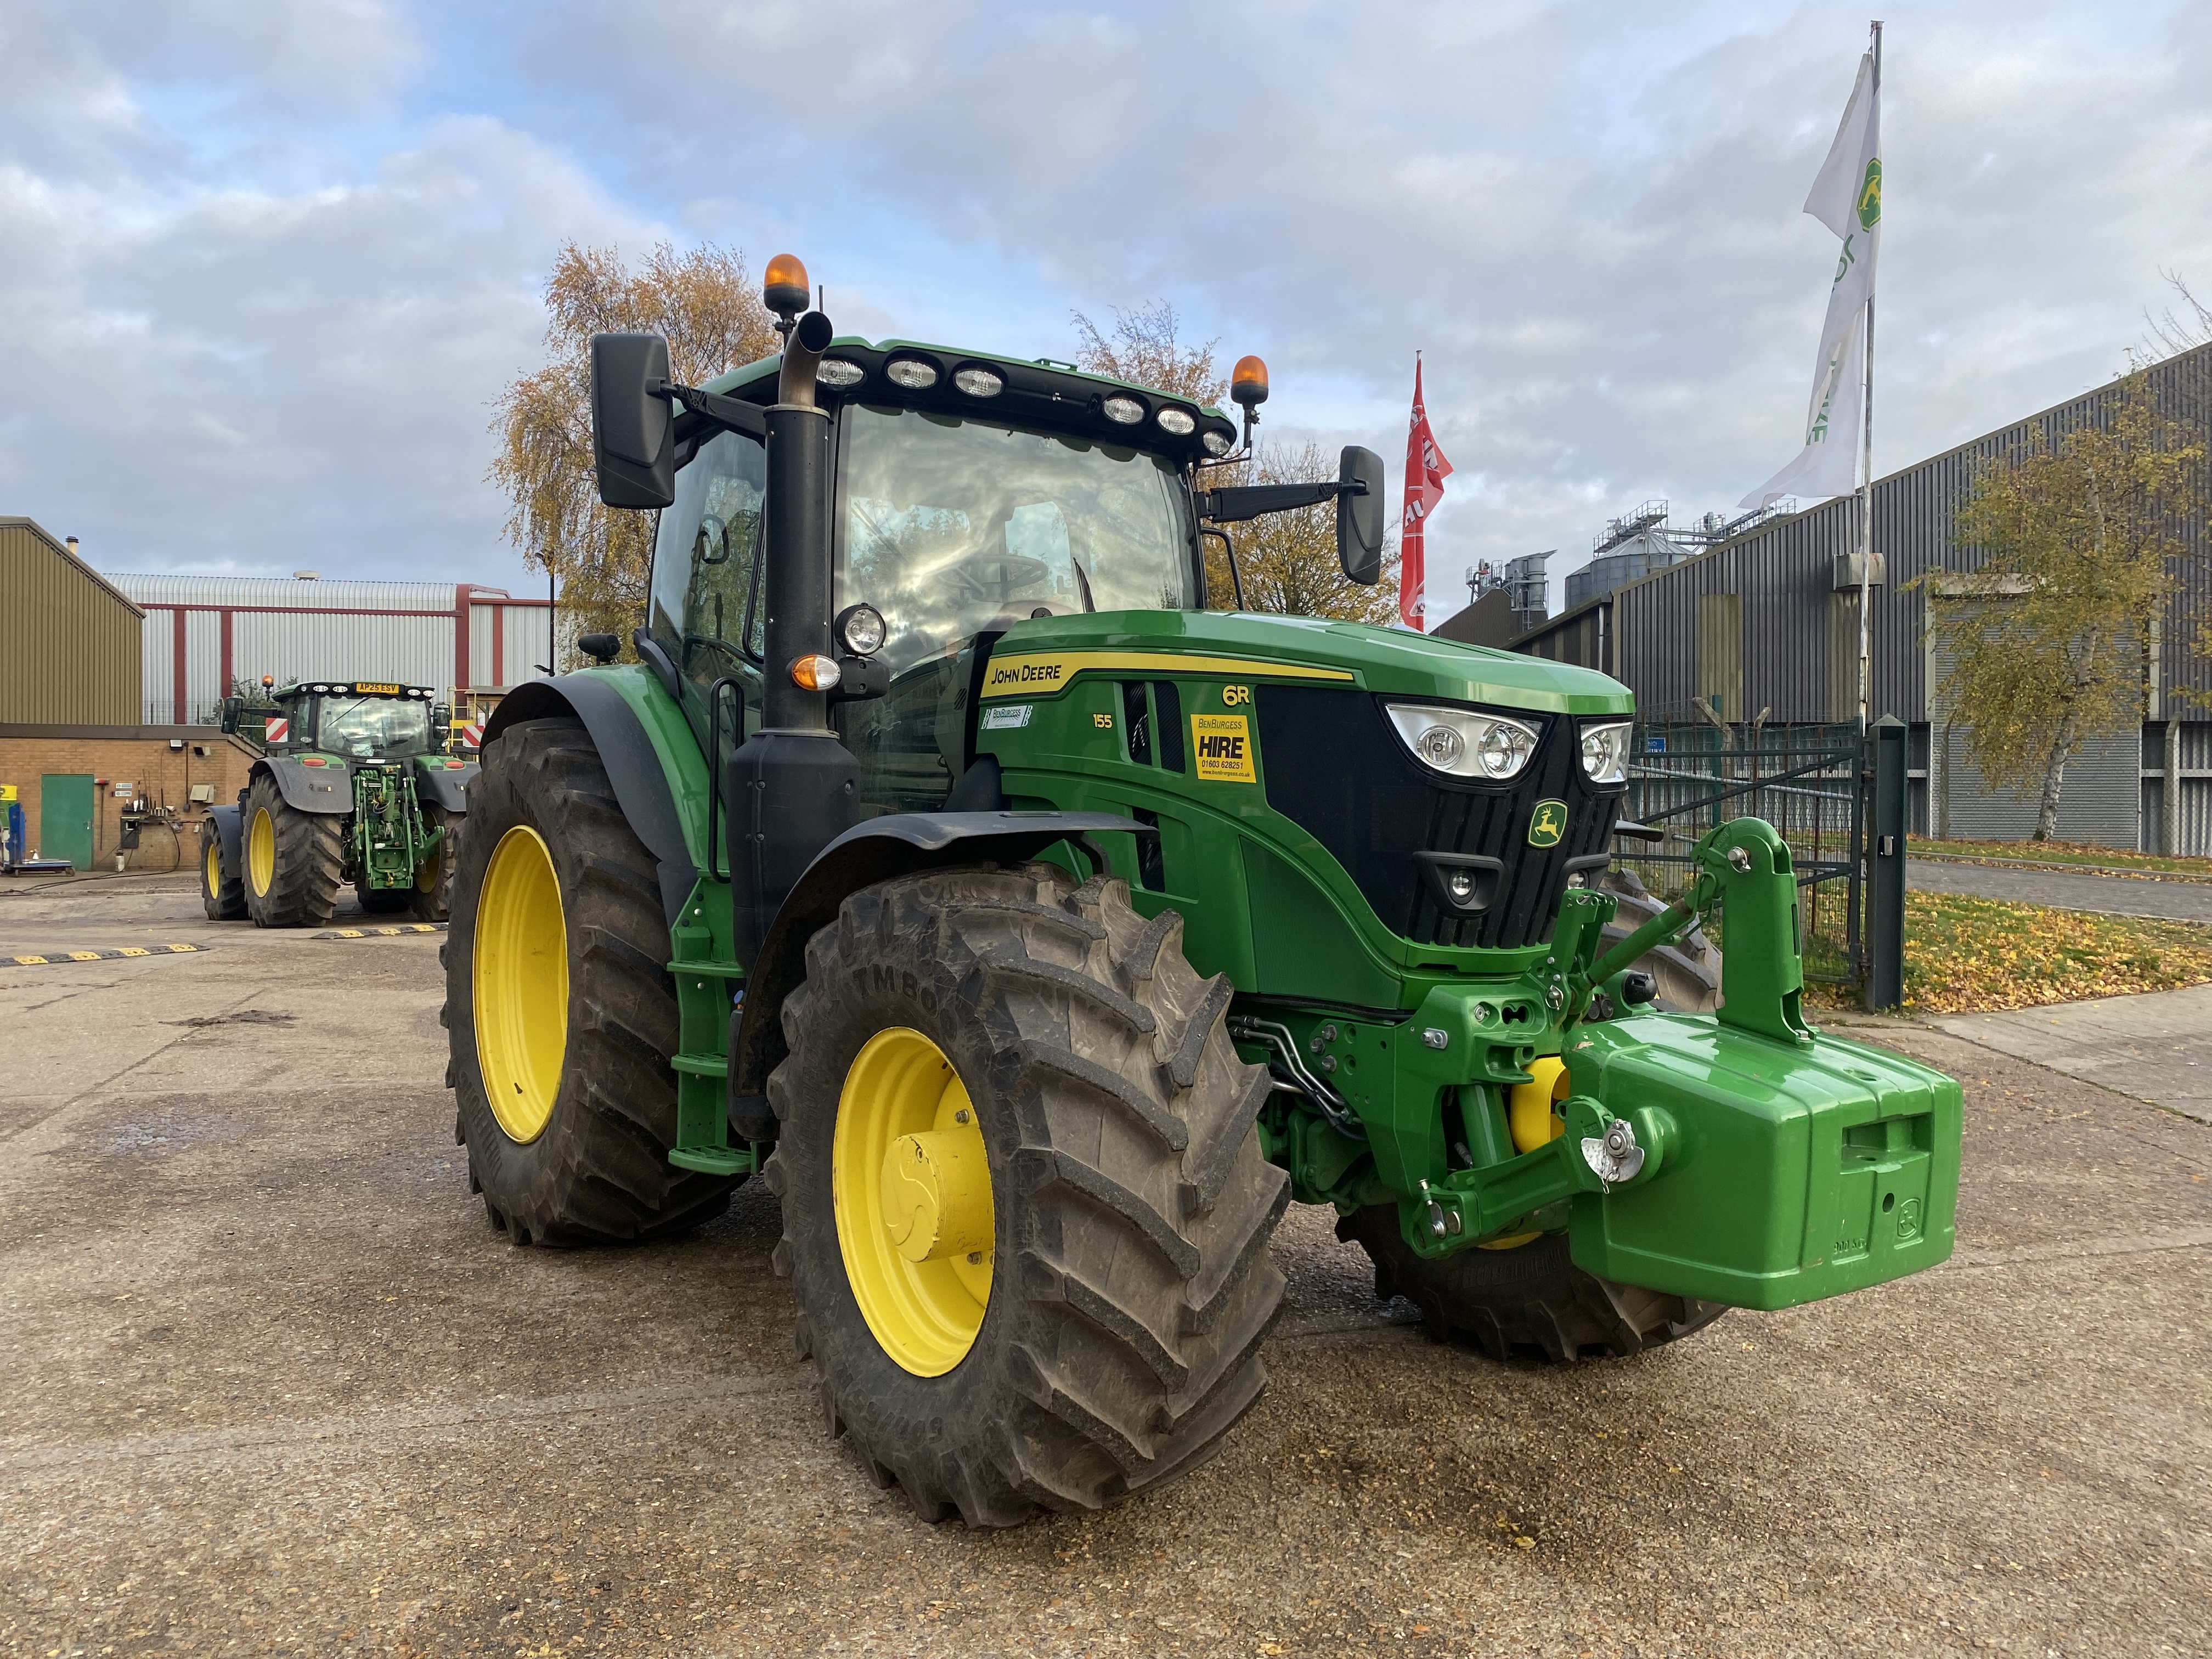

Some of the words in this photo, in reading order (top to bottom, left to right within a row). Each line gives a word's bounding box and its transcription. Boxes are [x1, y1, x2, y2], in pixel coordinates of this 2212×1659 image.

[991, 668, 1020, 685] JOHN
[1022, 664, 1062, 682] DEERE
[1222, 685, 1250, 707] 6R
[1093, 713, 1113, 729] 155
[1198, 736, 1244, 759] HIRE
[1201, 760, 1220, 768] 01603
[1221, 760, 1243, 770] 628251
[852, 964, 957, 1042] TM800
[792, 1046, 820, 1230] TRELLEBORG
